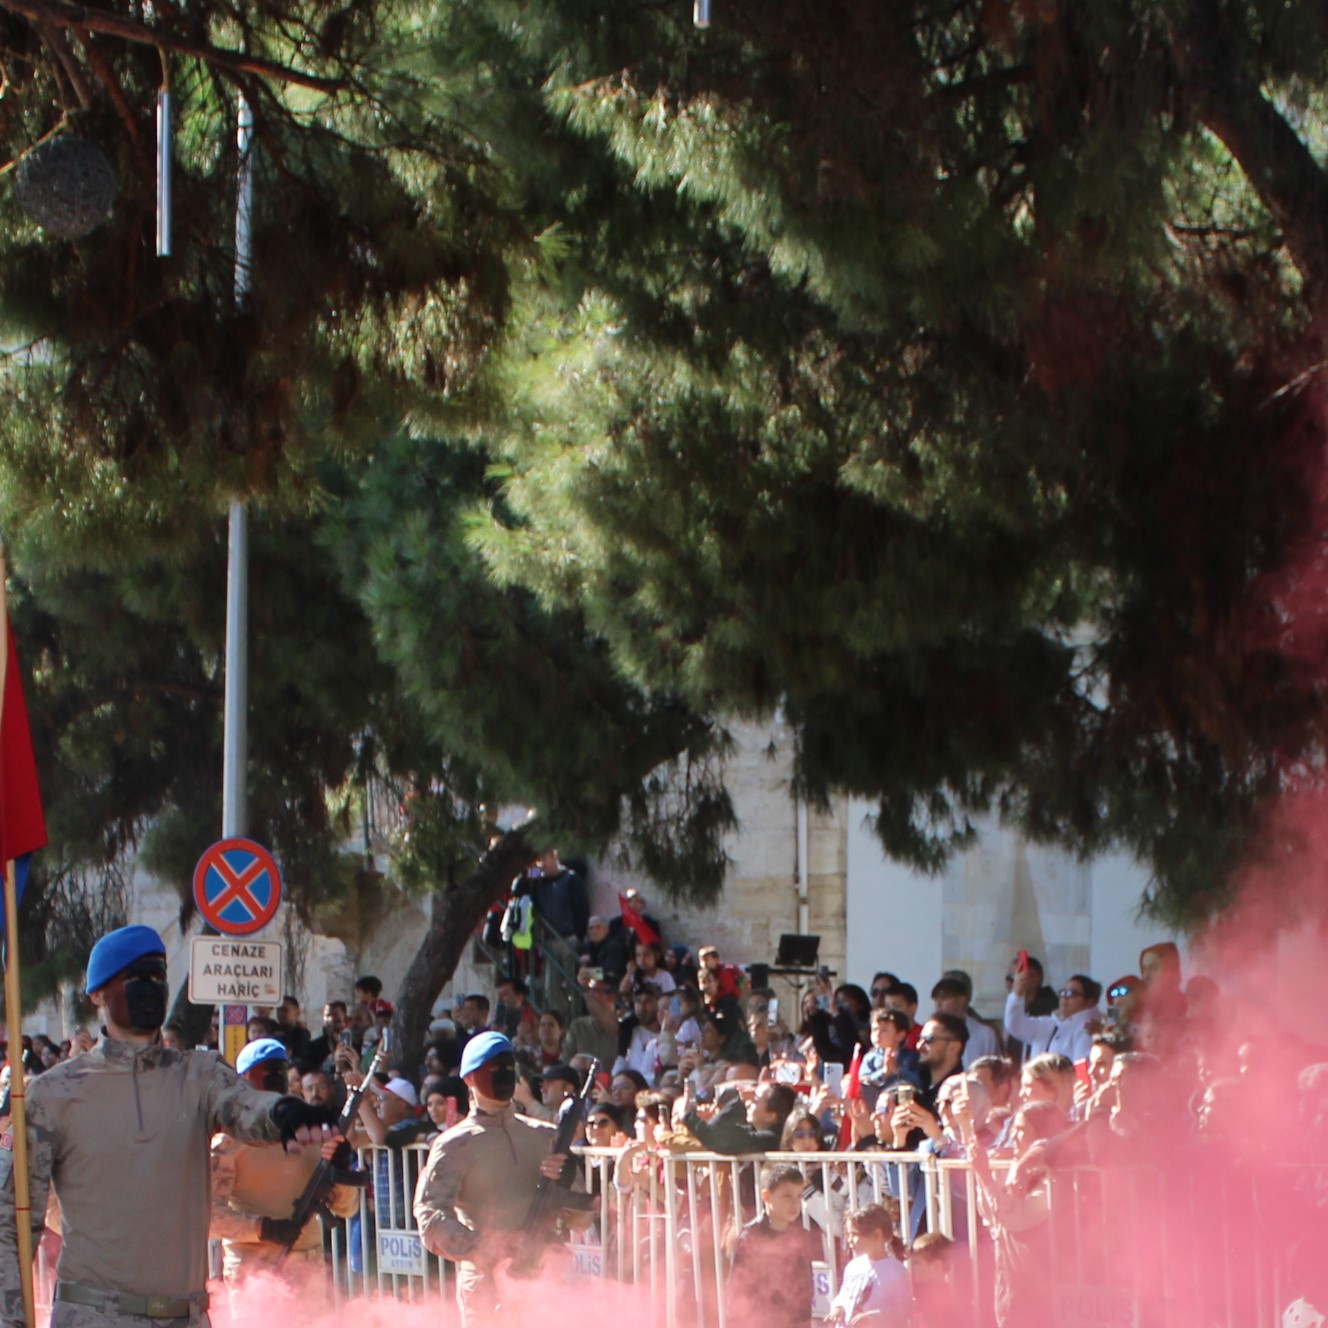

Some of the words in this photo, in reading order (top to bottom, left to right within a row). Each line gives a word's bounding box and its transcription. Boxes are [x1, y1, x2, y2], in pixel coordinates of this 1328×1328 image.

[212, 944, 265, 958] CENAZE
[203, 963, 272, 978] ARAÇLARI
[217, 981, 259, 998] HARİÇ
